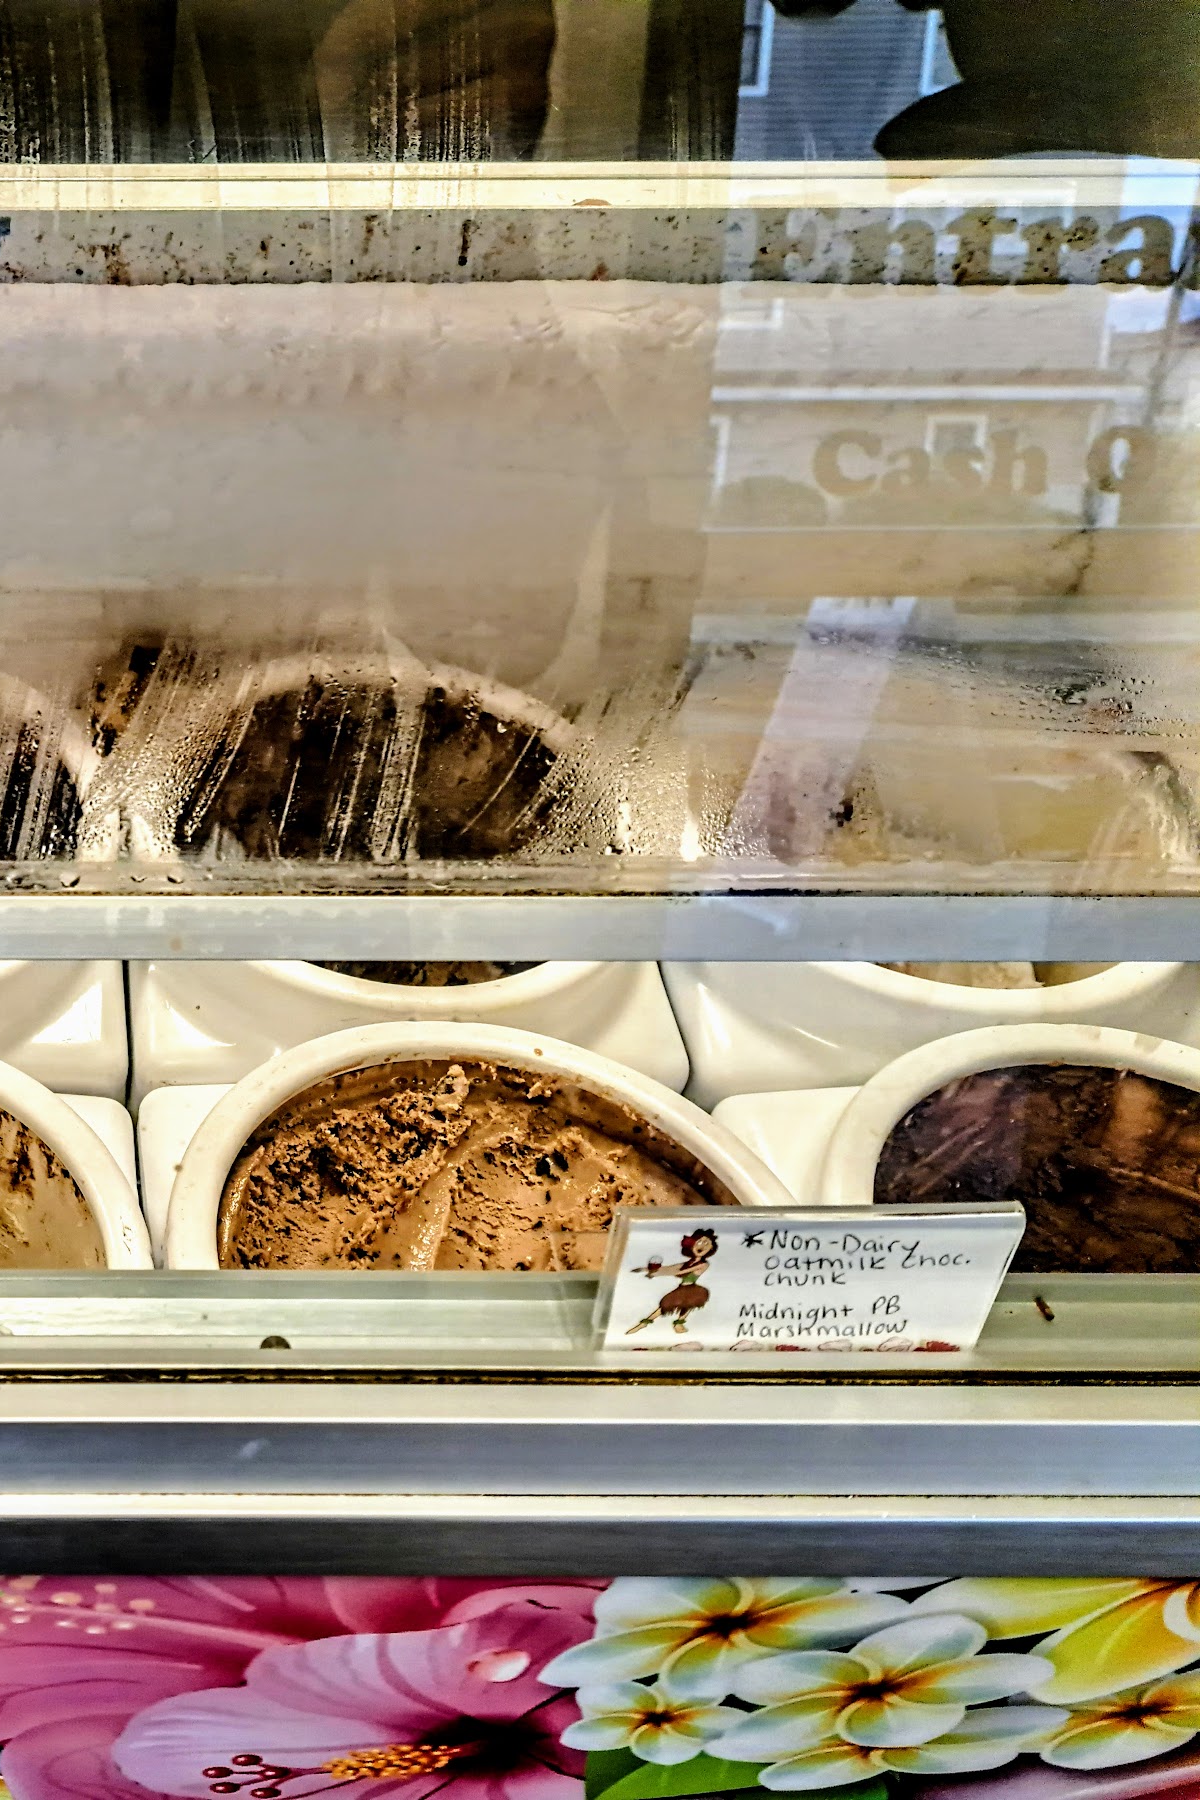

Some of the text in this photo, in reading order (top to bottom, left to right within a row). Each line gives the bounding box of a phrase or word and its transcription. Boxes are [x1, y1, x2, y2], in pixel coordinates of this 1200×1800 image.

[740, 196, 1200, 296] Entra
[814, 427, 1048, 497] Cash
[736, 1318, 908, 1339] Marshmallow
[738, 1294, 902, 1327] Midnight PB
